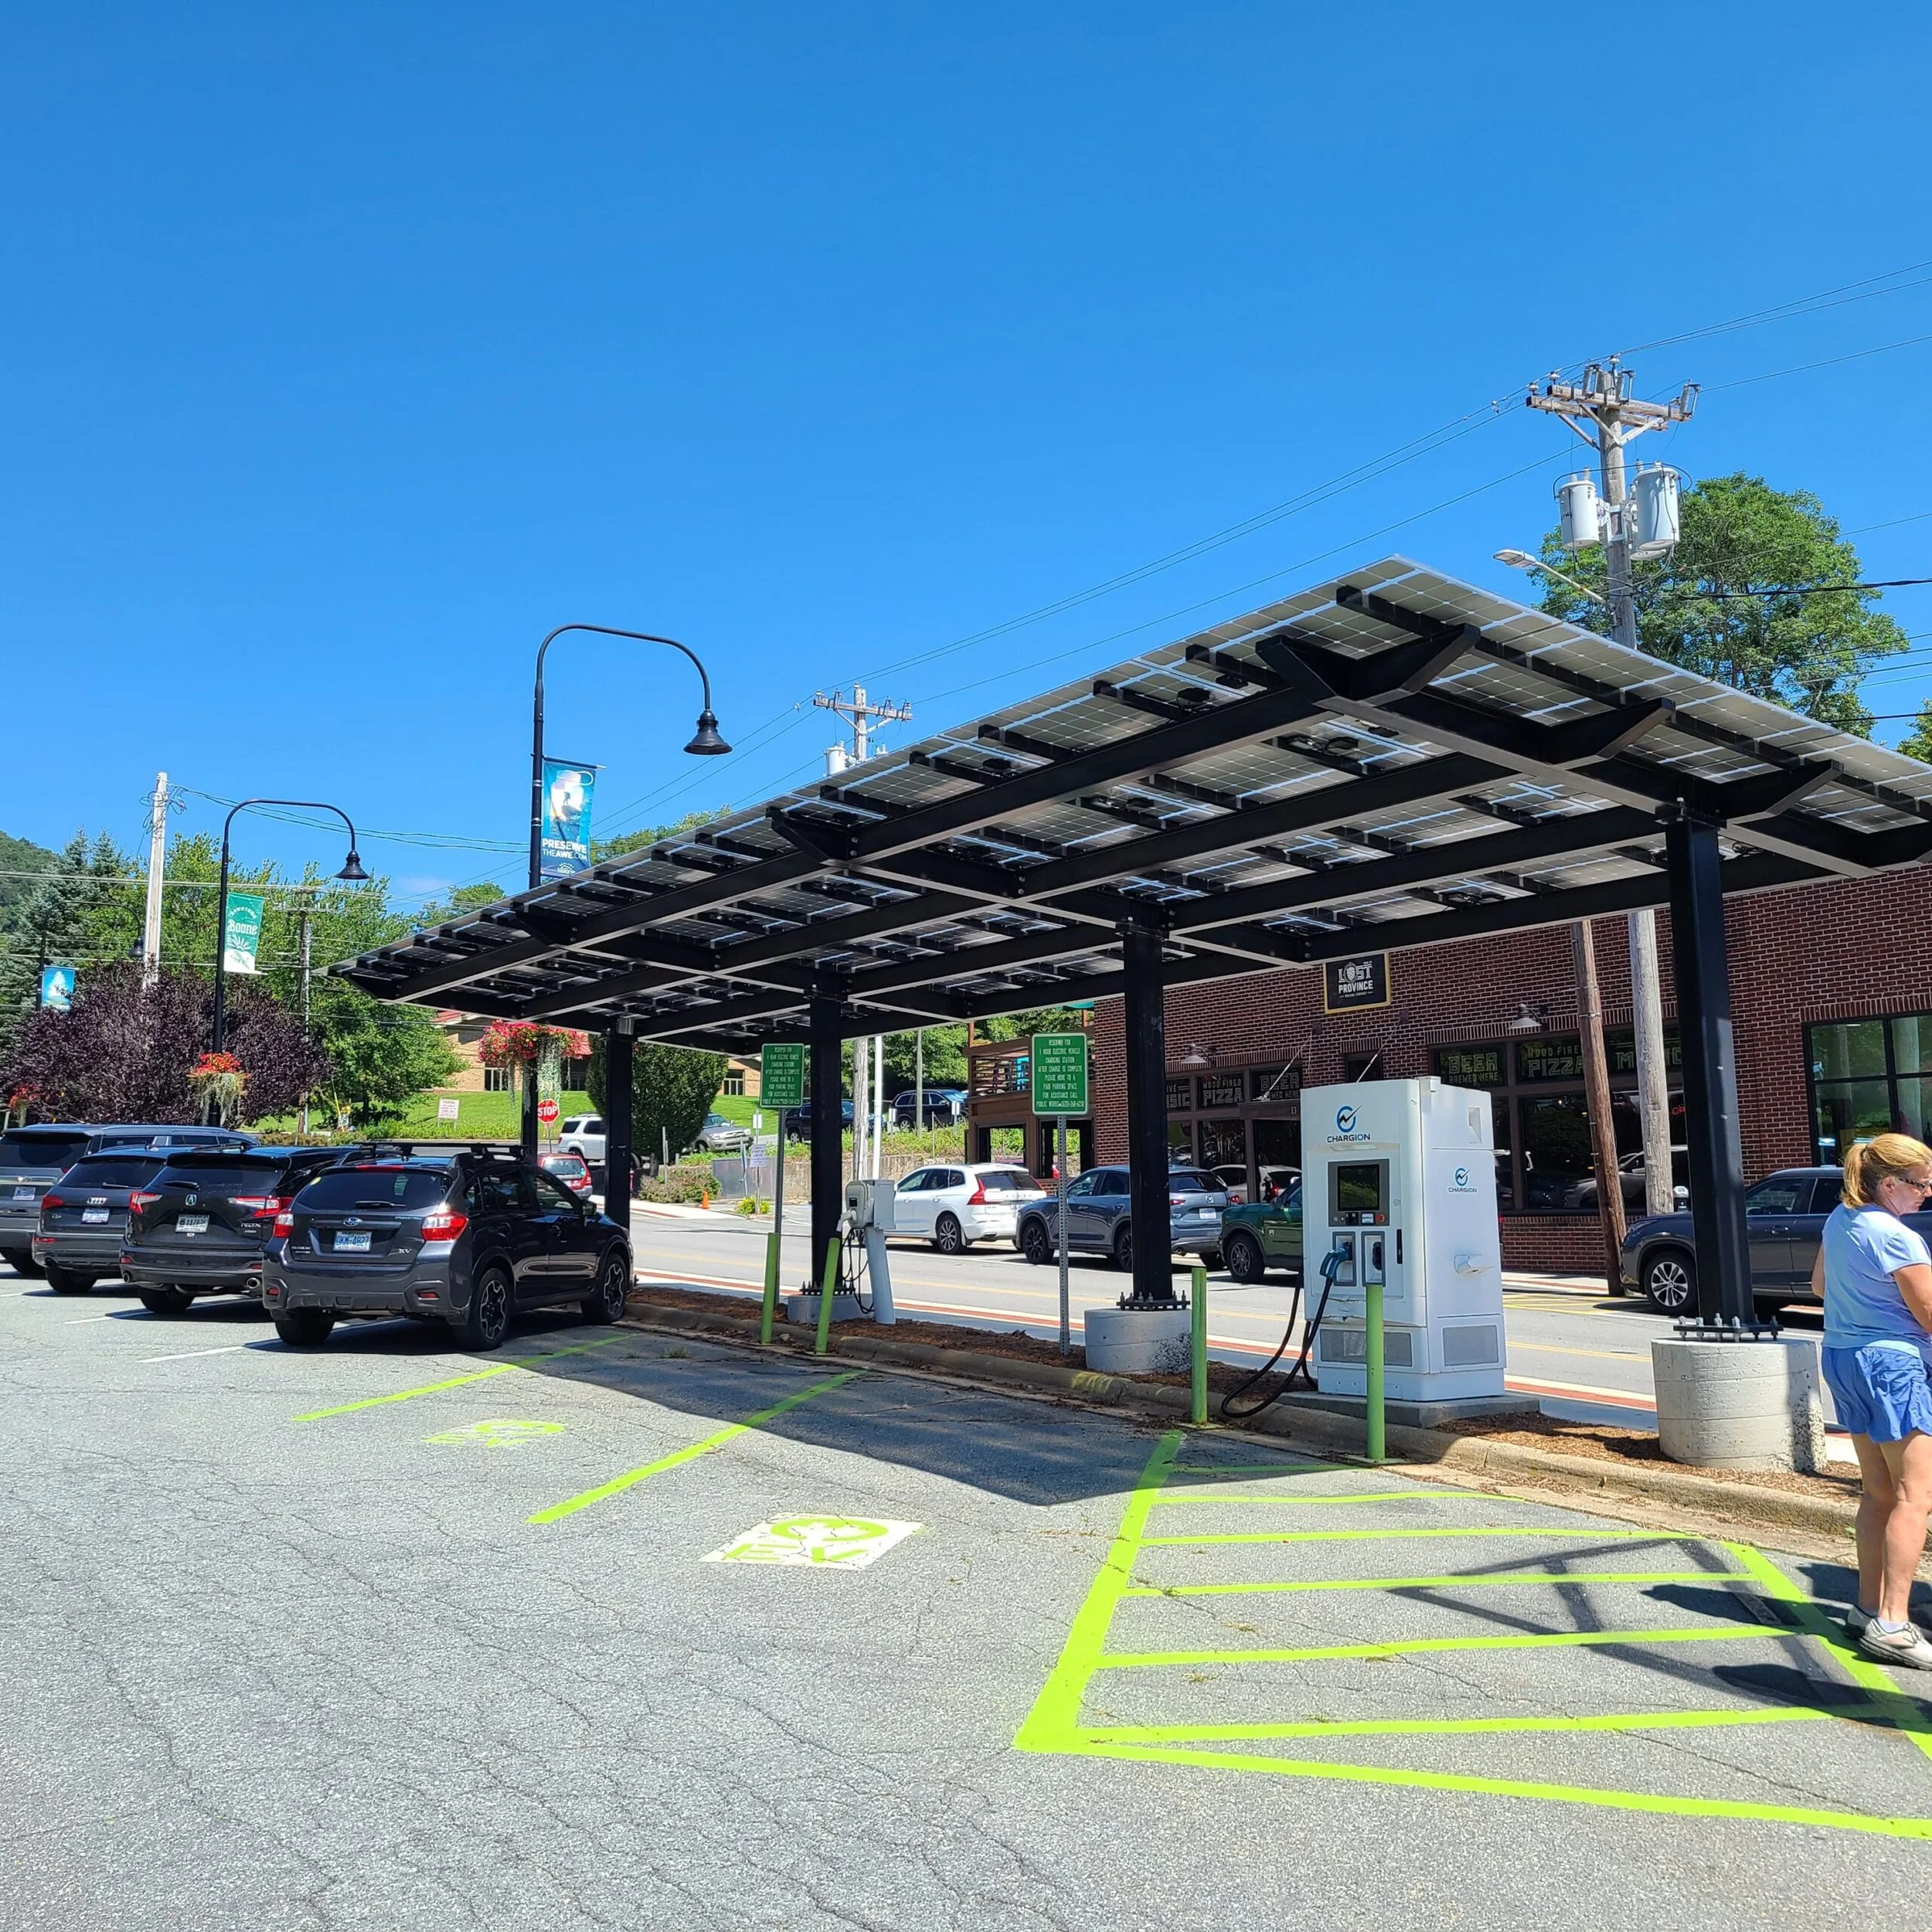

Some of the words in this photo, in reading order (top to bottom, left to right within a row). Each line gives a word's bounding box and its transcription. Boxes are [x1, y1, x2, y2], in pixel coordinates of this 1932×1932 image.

[1338, 961, 1372, 983] LOST
[1338, 980, 1373, 994] PROVINCE
[1528, 1048, 1553, 1058] WOOD
[1448, 1053, 1498, 1074] BEER
[1223, 1077, 1242, 1087] FIRED
[1260, 1073, 1300, 1091] BEER
[1449, 1074, 1476, 1083] BREWED
[1478, 1072, 1498, 1082] HERE
[1203, 1087, 1243, 1106] PIZZA
[537, 1107, 558, 1117] STOP
[1327, 1134, 1371, 1143] CHARGION
[723, 1543, 869, 1563] EV
